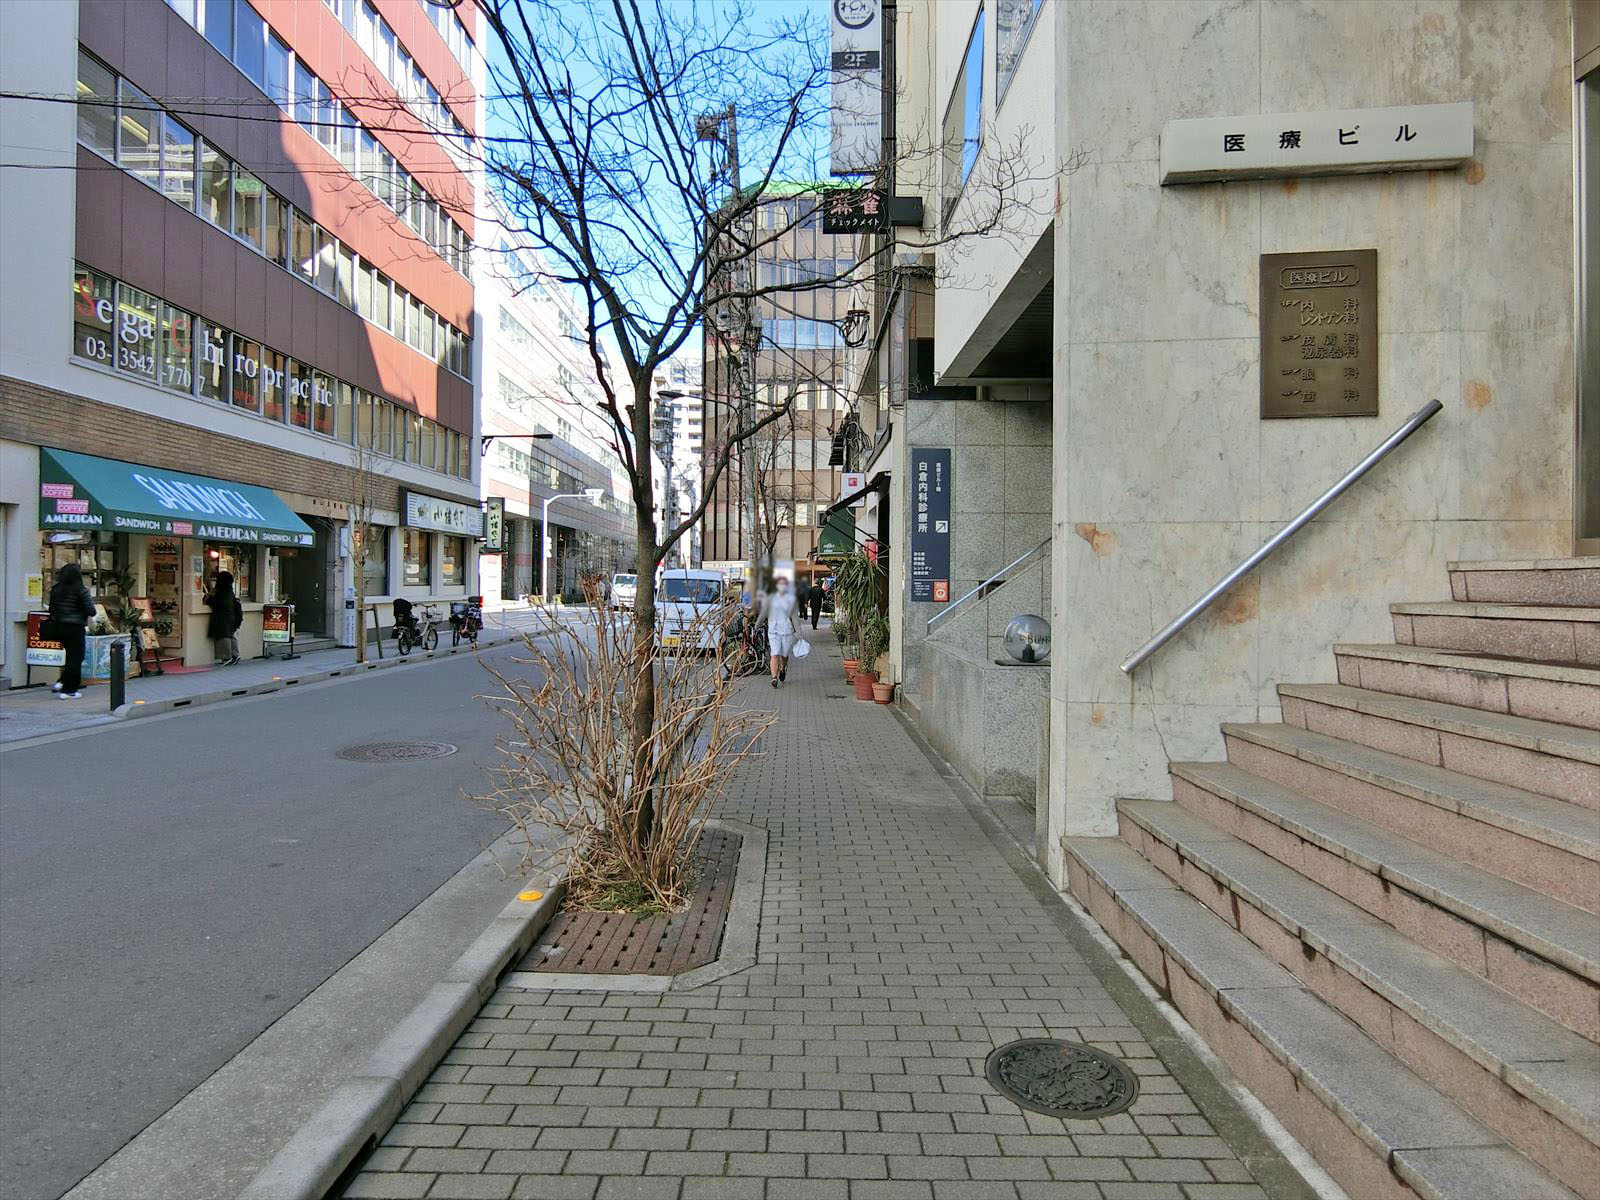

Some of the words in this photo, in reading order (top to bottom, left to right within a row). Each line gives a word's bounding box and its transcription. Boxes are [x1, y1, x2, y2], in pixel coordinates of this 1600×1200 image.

[844, 53, 867, 67] 2F
[1223, 124, 1417, 153] 医療ビル
[830, 192, 880, 215] 麻雀
[831, 218, 880, 226] チェックメイト
[1289, 270, 1349, 285] 医療ビル
[76, 278, 154, 344] Sega
[131, 473, 266, 522] SANDWICH
[918, 462, 928, 533] 白倉内科診療所
[45, 514, 103, 525] AMERICAN
[115, 516, 161, 530] SANDWICH
[166, 523, 173, 531] &
[198, 525, 258, 541] AMERICAN
[262, 533, 291, 543] SANDWICH
[30, 640, 62, 649] COFFEE
[28, 653, 63, 662] AMERICAN
